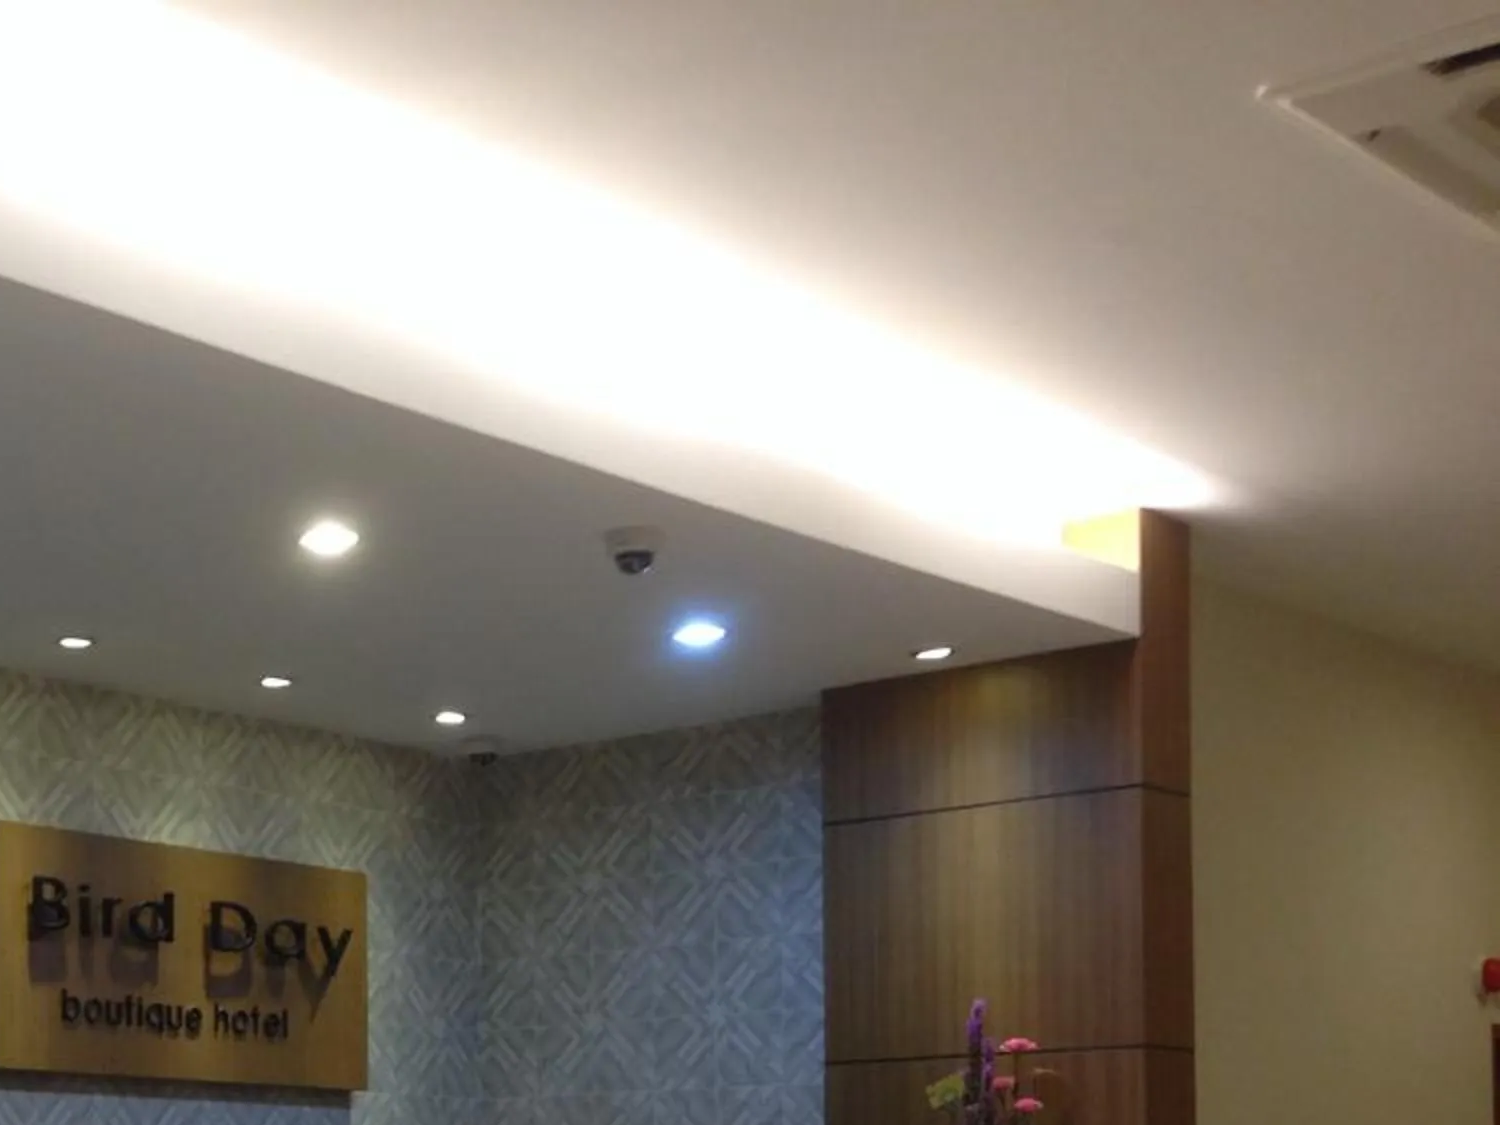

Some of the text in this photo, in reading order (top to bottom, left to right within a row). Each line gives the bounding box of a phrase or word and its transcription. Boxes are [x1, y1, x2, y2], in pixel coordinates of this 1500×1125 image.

[30, 876, 353, 978] Bird Day
[60, 989, 288, 1040] boutique hotel
